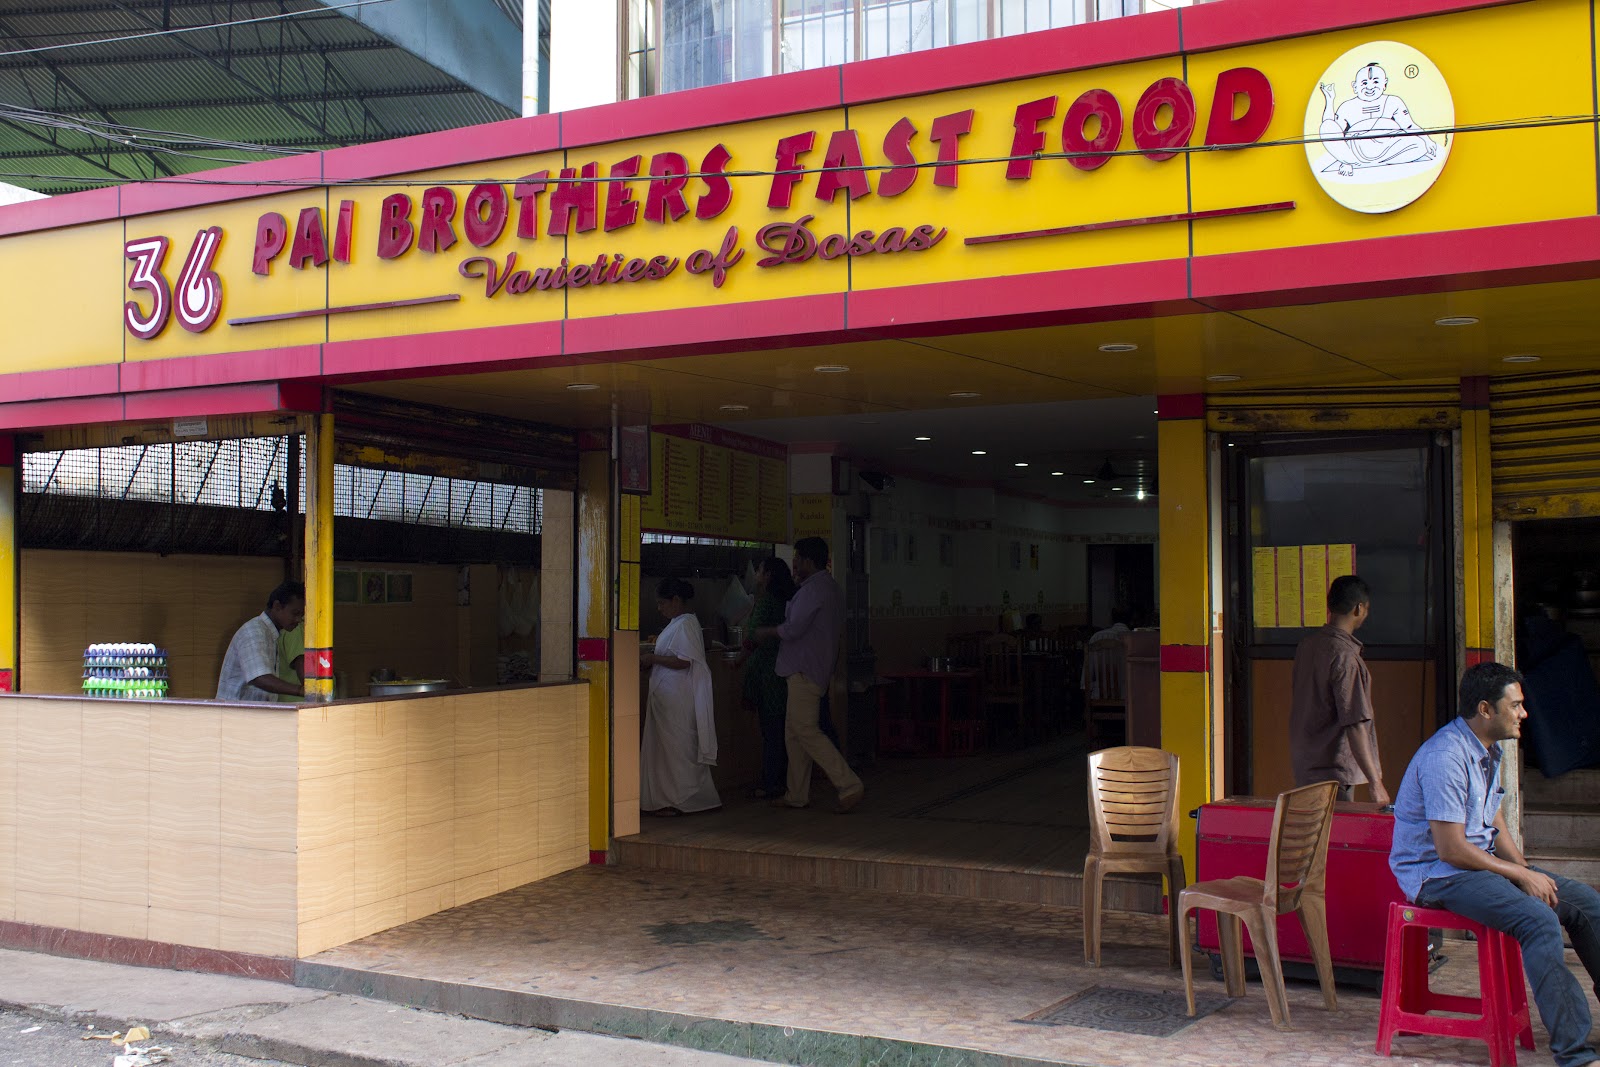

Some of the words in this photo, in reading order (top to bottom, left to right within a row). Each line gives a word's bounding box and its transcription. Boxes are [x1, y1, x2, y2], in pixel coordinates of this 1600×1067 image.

[124, 226, 223, 340] 36
[252, 200, 354, 275] PAI
[377, 143, 733, 260] BROTHERS
[767, 109, 974, 208] FAST
[1006, 67, 1275, 179] FOOD
[458, 251, 678, 298] Varieties
[685, 226, 745, 288] of
[755, 215, 947, 268] Dosas
[689, 424, 712, 439] MENU
